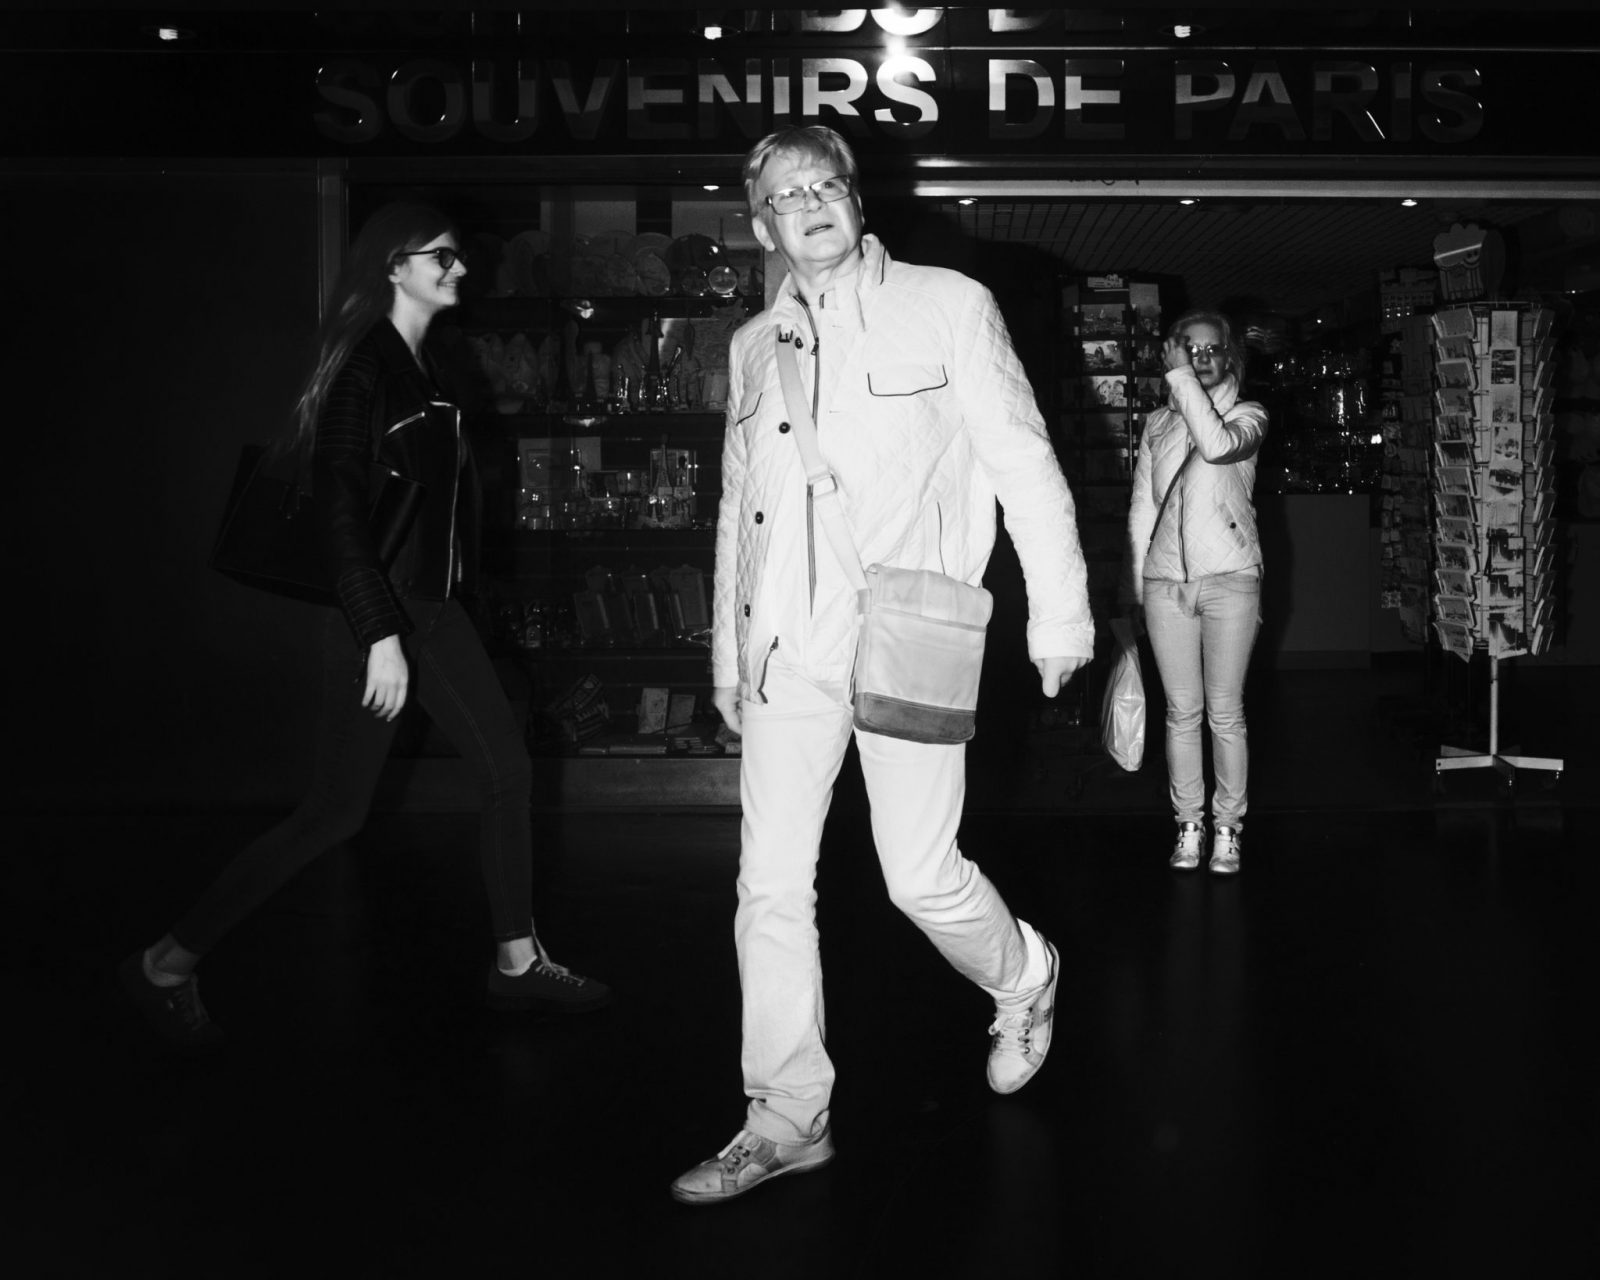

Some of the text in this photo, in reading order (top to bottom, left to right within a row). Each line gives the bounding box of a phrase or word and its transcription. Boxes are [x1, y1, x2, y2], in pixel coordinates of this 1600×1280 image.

[312, 55, 1485, 145] SOUVENIRS DE PARIS
